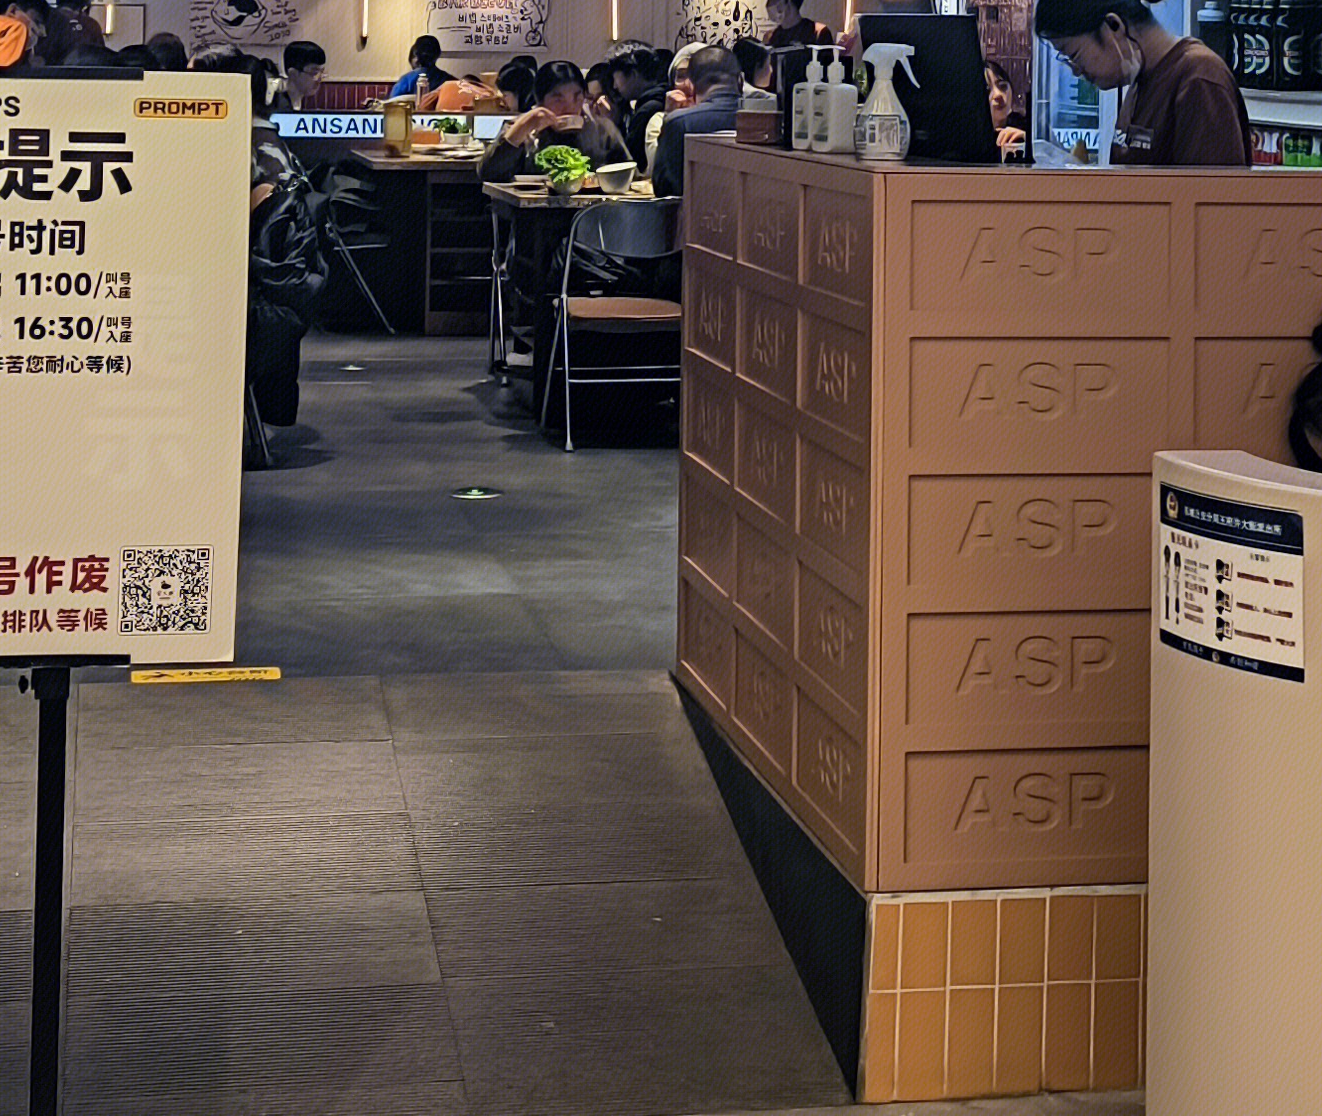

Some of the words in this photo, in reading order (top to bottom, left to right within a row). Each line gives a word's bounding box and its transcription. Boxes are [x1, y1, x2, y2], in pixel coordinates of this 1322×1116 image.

[138, 100, 225, 117] PROMPT
[960, 226, 1119, 282] ASP
[958, 361, 1120, 422] ASP
[957, 498, 1119, 559] ASP
[956, 636, 1118, 695] ASP
[954, 772, 1117, 834] ASP
